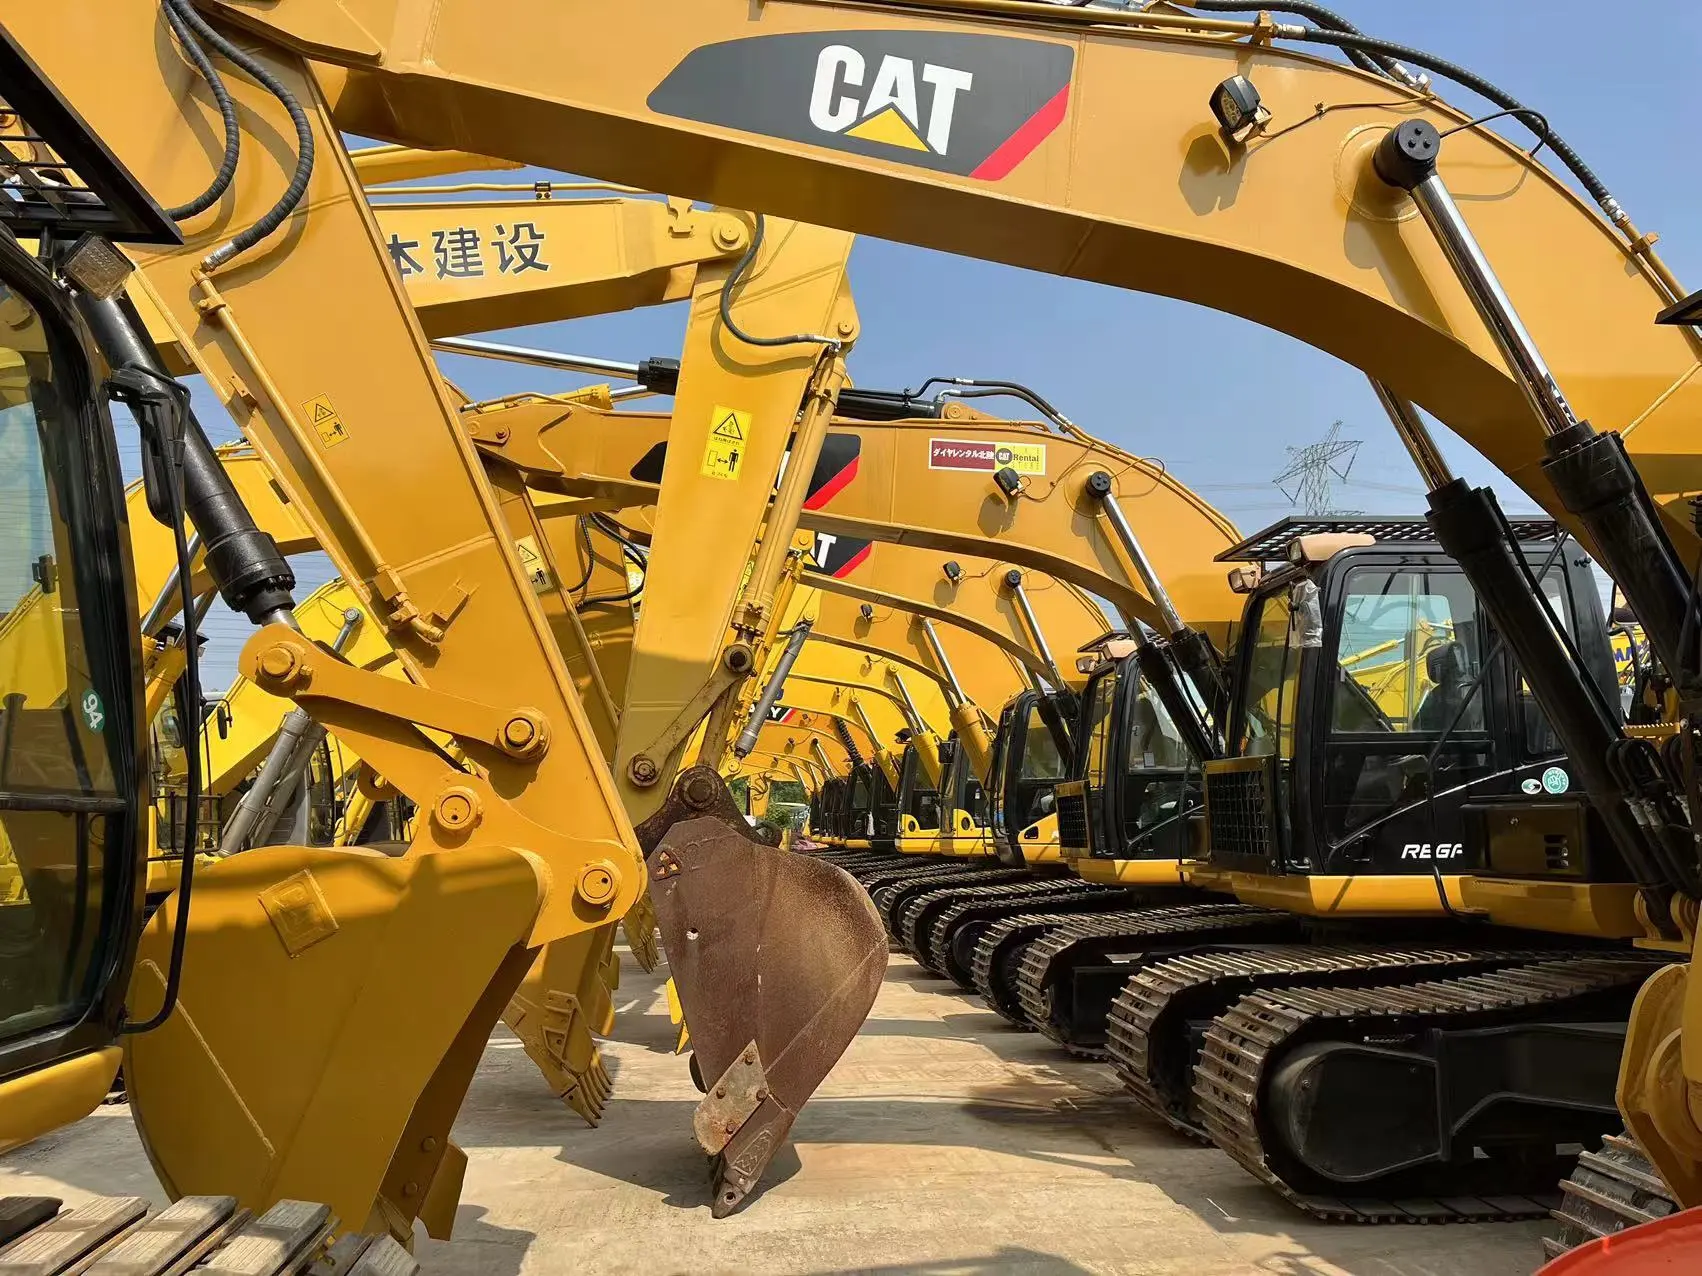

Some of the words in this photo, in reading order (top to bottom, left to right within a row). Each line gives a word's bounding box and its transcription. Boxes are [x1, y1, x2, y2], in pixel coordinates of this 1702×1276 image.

[809, 44, 973, 156] CAT
[998, 452, 1010, 460] CAT
[1013, 453, 1039, 462] Rental
[82, 693, 104, 729] 94
